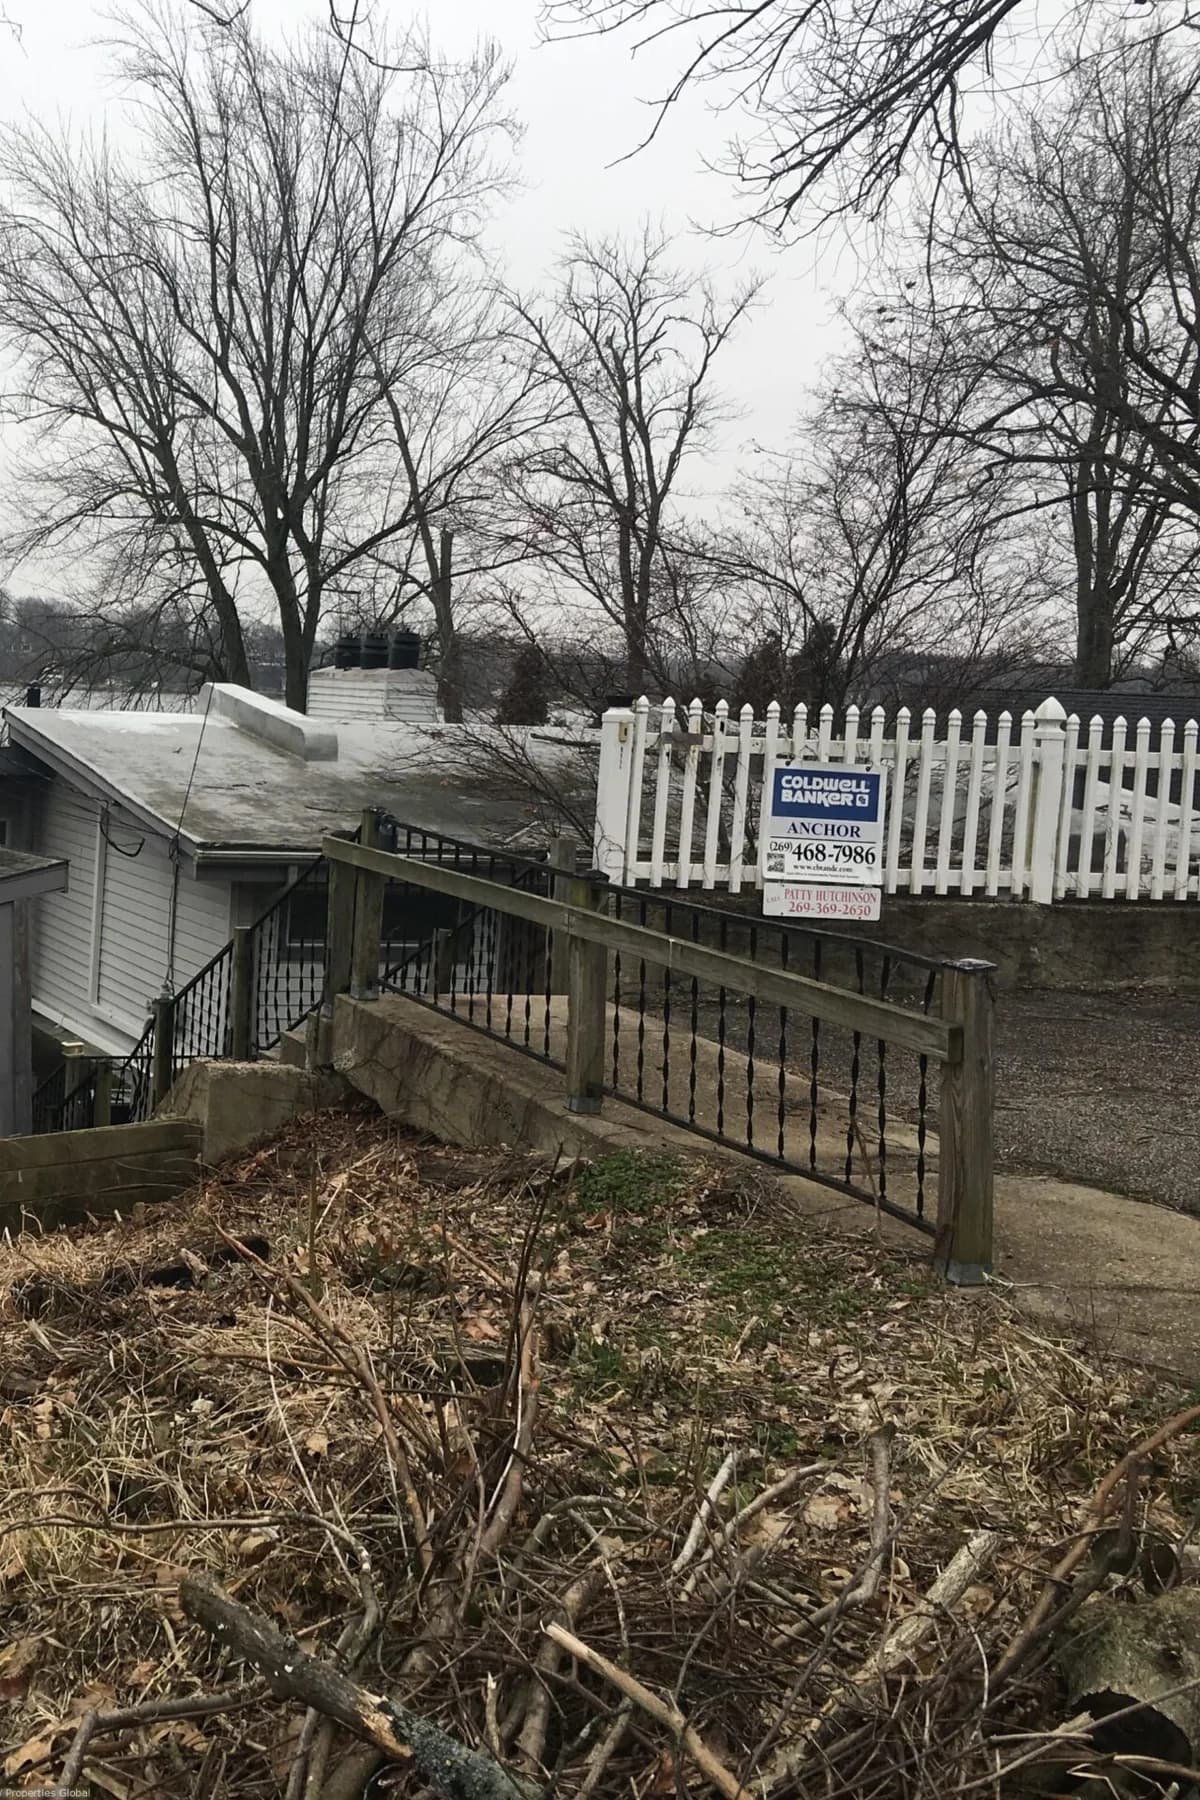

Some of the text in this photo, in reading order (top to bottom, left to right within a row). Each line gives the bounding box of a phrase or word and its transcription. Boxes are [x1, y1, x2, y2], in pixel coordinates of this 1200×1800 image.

[787, 821, 861, 838] ANCHOR
[769, 841, 876, 865] (269) 468-7986
[784, 888, 877, 903] PATTY HUTCHINSON
[788, 901, 872, 916] 269-369-2650
